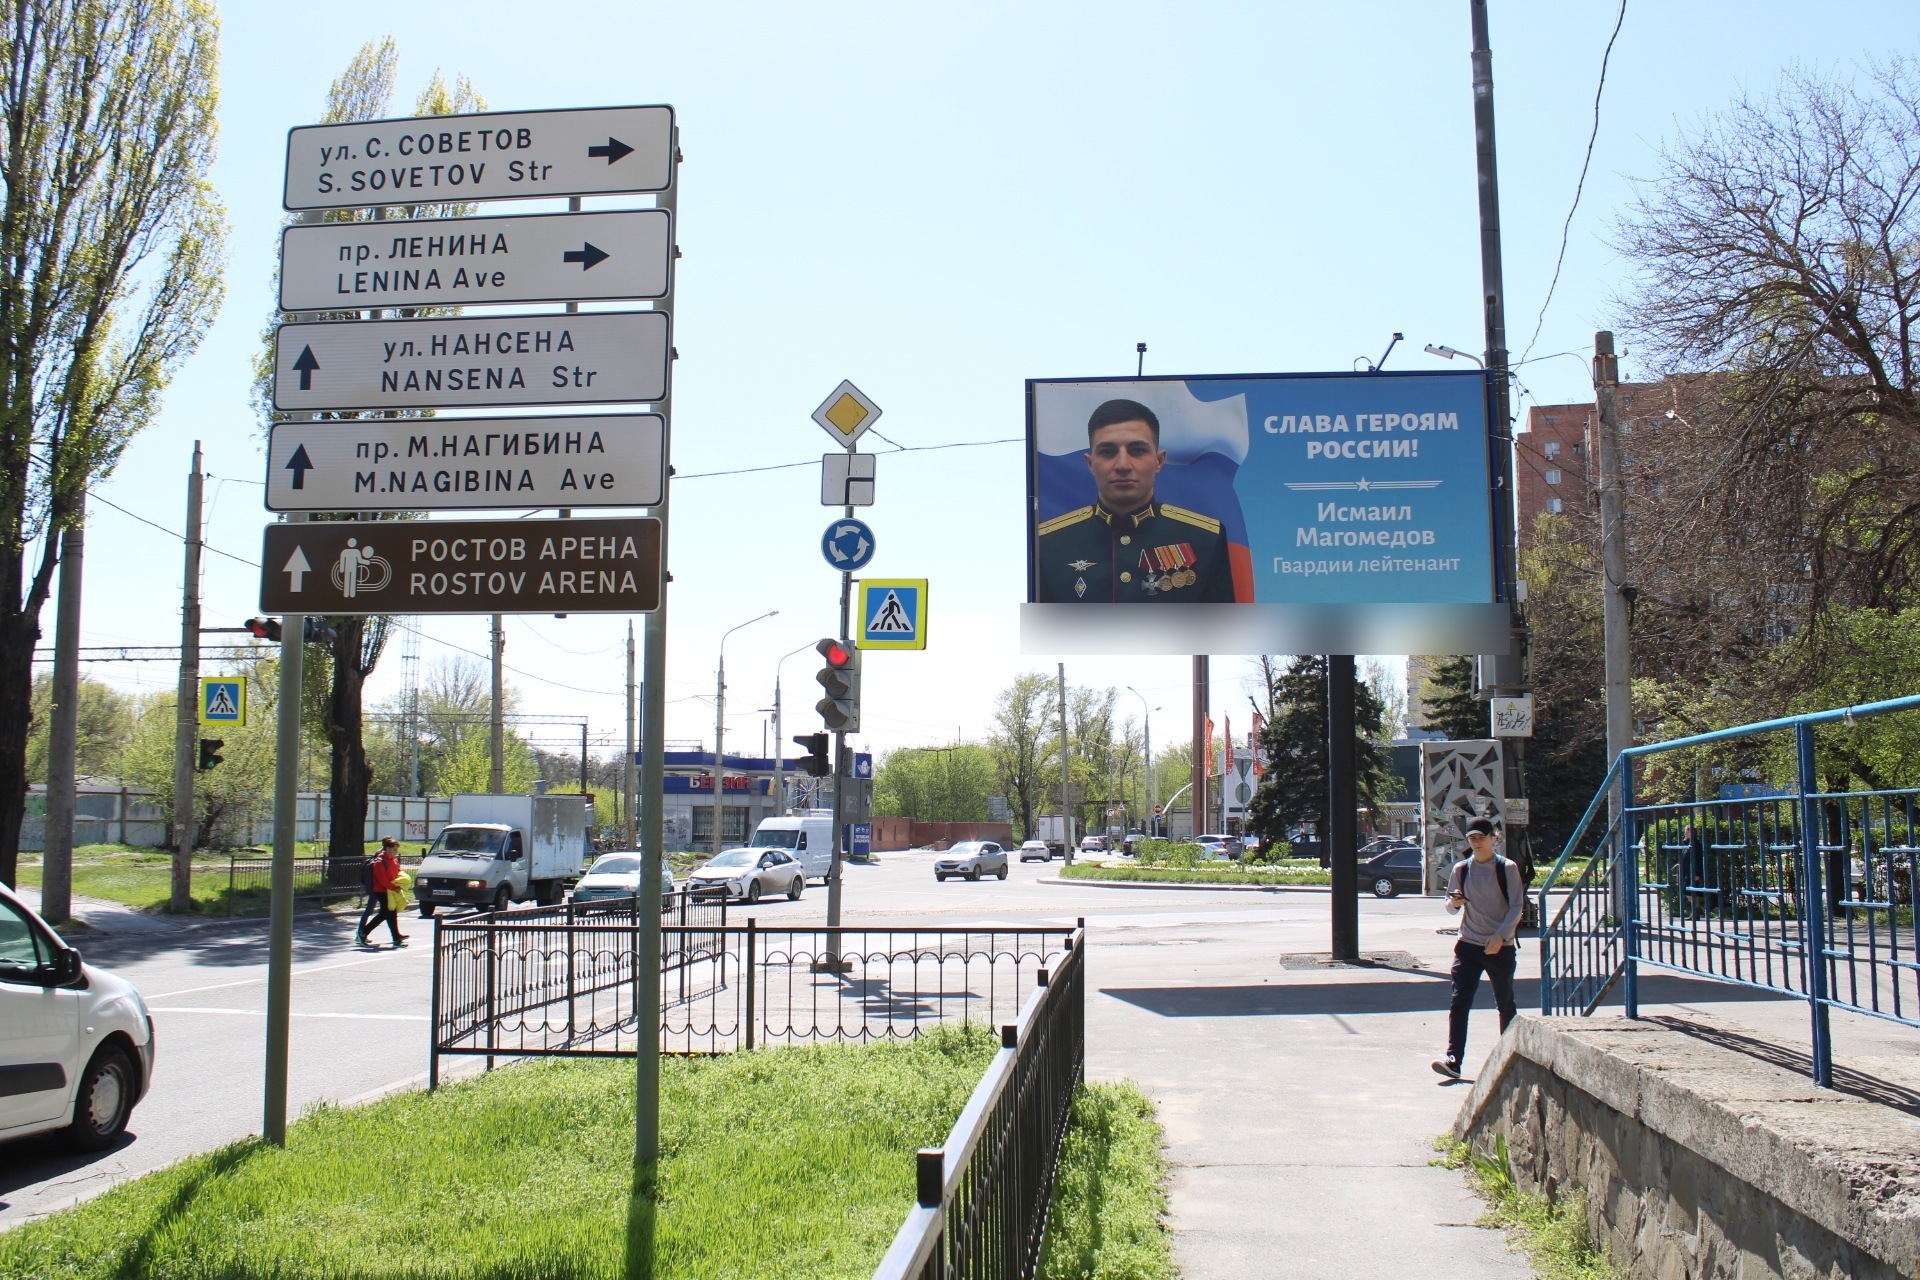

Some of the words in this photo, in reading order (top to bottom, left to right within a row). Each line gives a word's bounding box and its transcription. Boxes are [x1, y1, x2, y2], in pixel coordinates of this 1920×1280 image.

[320, 145, 357, 168] ул.
[508, 160, 553, 182] Str
[339, 244, 380, 267] пр.
[388, 233, 509, 259] ЛЕНИНА
[337, 268, 442, 294] LENINA
[452, 267, 506, 289] Ave
[383, 341, 423, 363] ул.
[431, 330, 575, 357] НАНСЕНА
[381, 366, 526, 393] NANSENA
[552, 365, 598, 388] Str
[1263, 414, 1350, 434] СЛАВА
[1355, 412, 1459, 432] ГЕРОЯМ
[356, 442, 399, 465] пр.
[1306, 438, 1418, 459] РОССИИ!
[560, 468, 615, 491] Ave
[1317, 502, 1412, 522] Исмаил
[411, 538, 526, 562] РОСТОВ
[539, 536, 639, 560] АРЕНА
[1296, 527, 1436, 549] Магомедов
[1273, 557, 1353, 578] Гвардии
[1357, 555, 1461, 572] лейтенант
[410, 571, 527, 596] ROSTOV
[538, 570, 638, 594] ARENA
